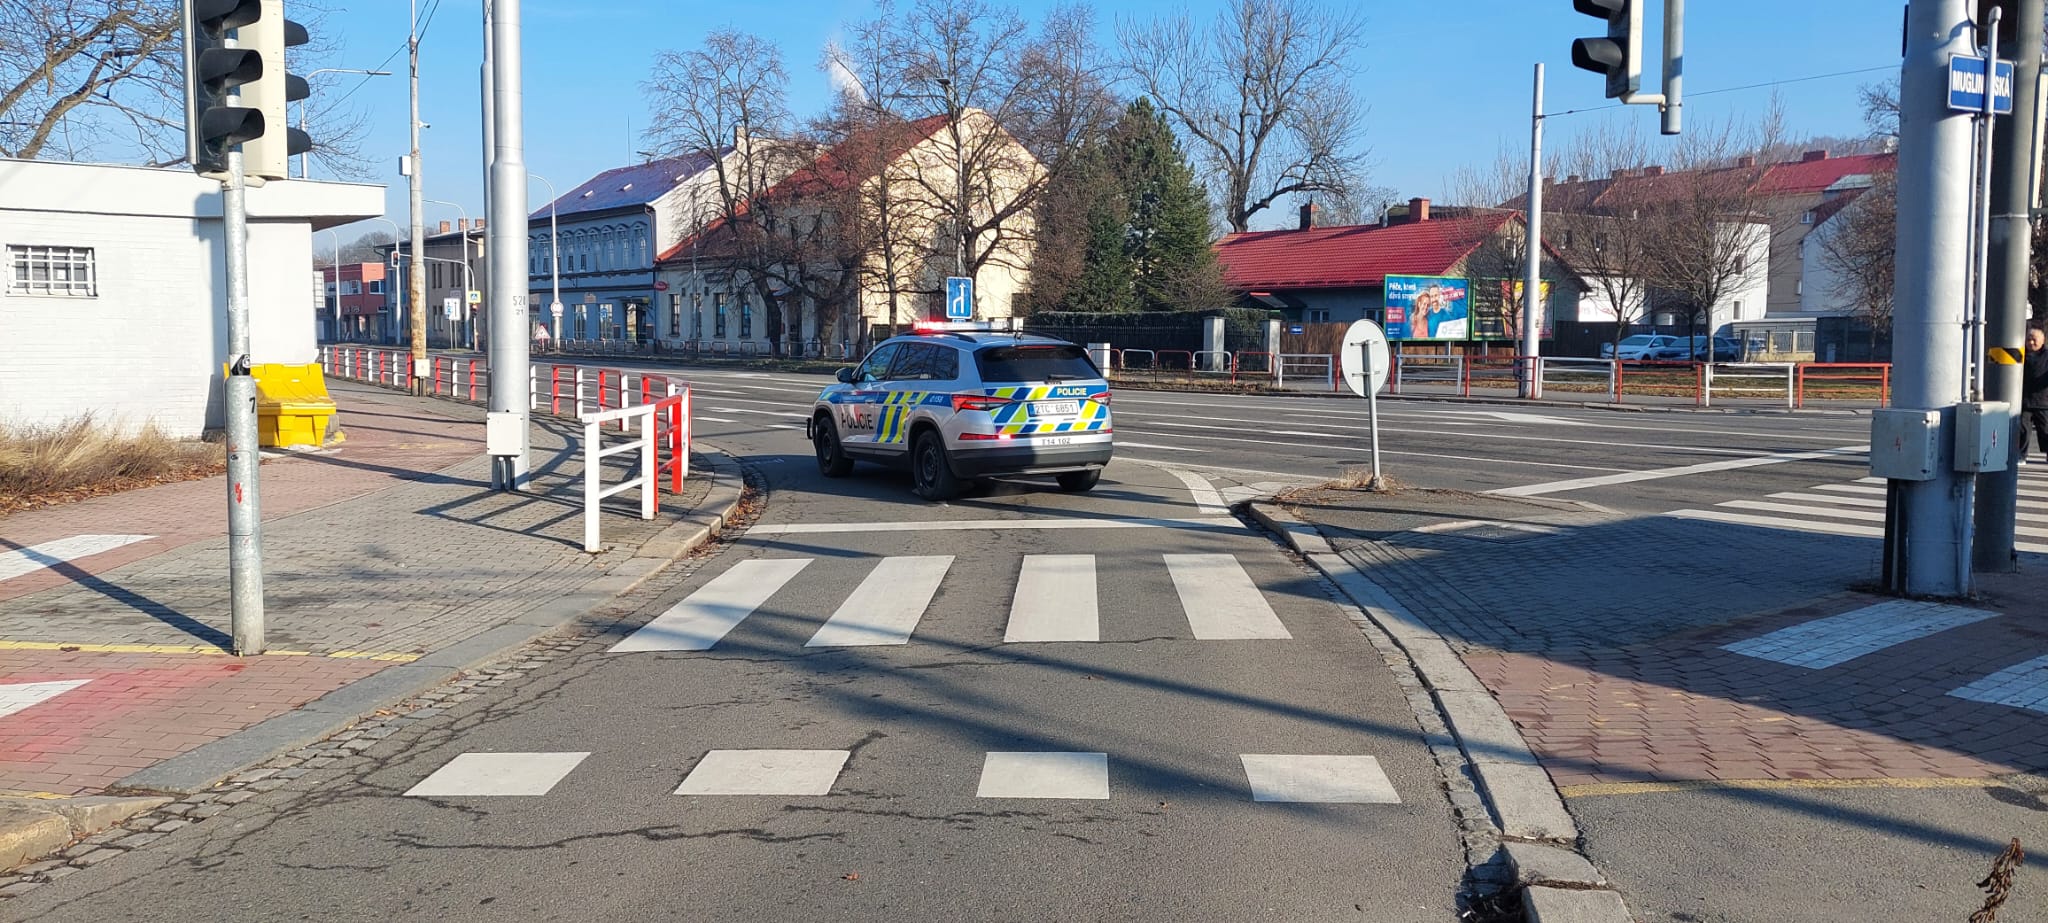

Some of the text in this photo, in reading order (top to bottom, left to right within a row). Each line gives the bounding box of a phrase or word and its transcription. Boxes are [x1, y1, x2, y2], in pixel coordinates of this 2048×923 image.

[1952, 70, 2010, 98] MUGLINSKÁ
[1056, 387, 1087, 396] POLICIE
[249, 396, 256, 414] 7
[1035, 403, 1051, 413] 2TC
[841, 413, 874, 430] POLICIE
